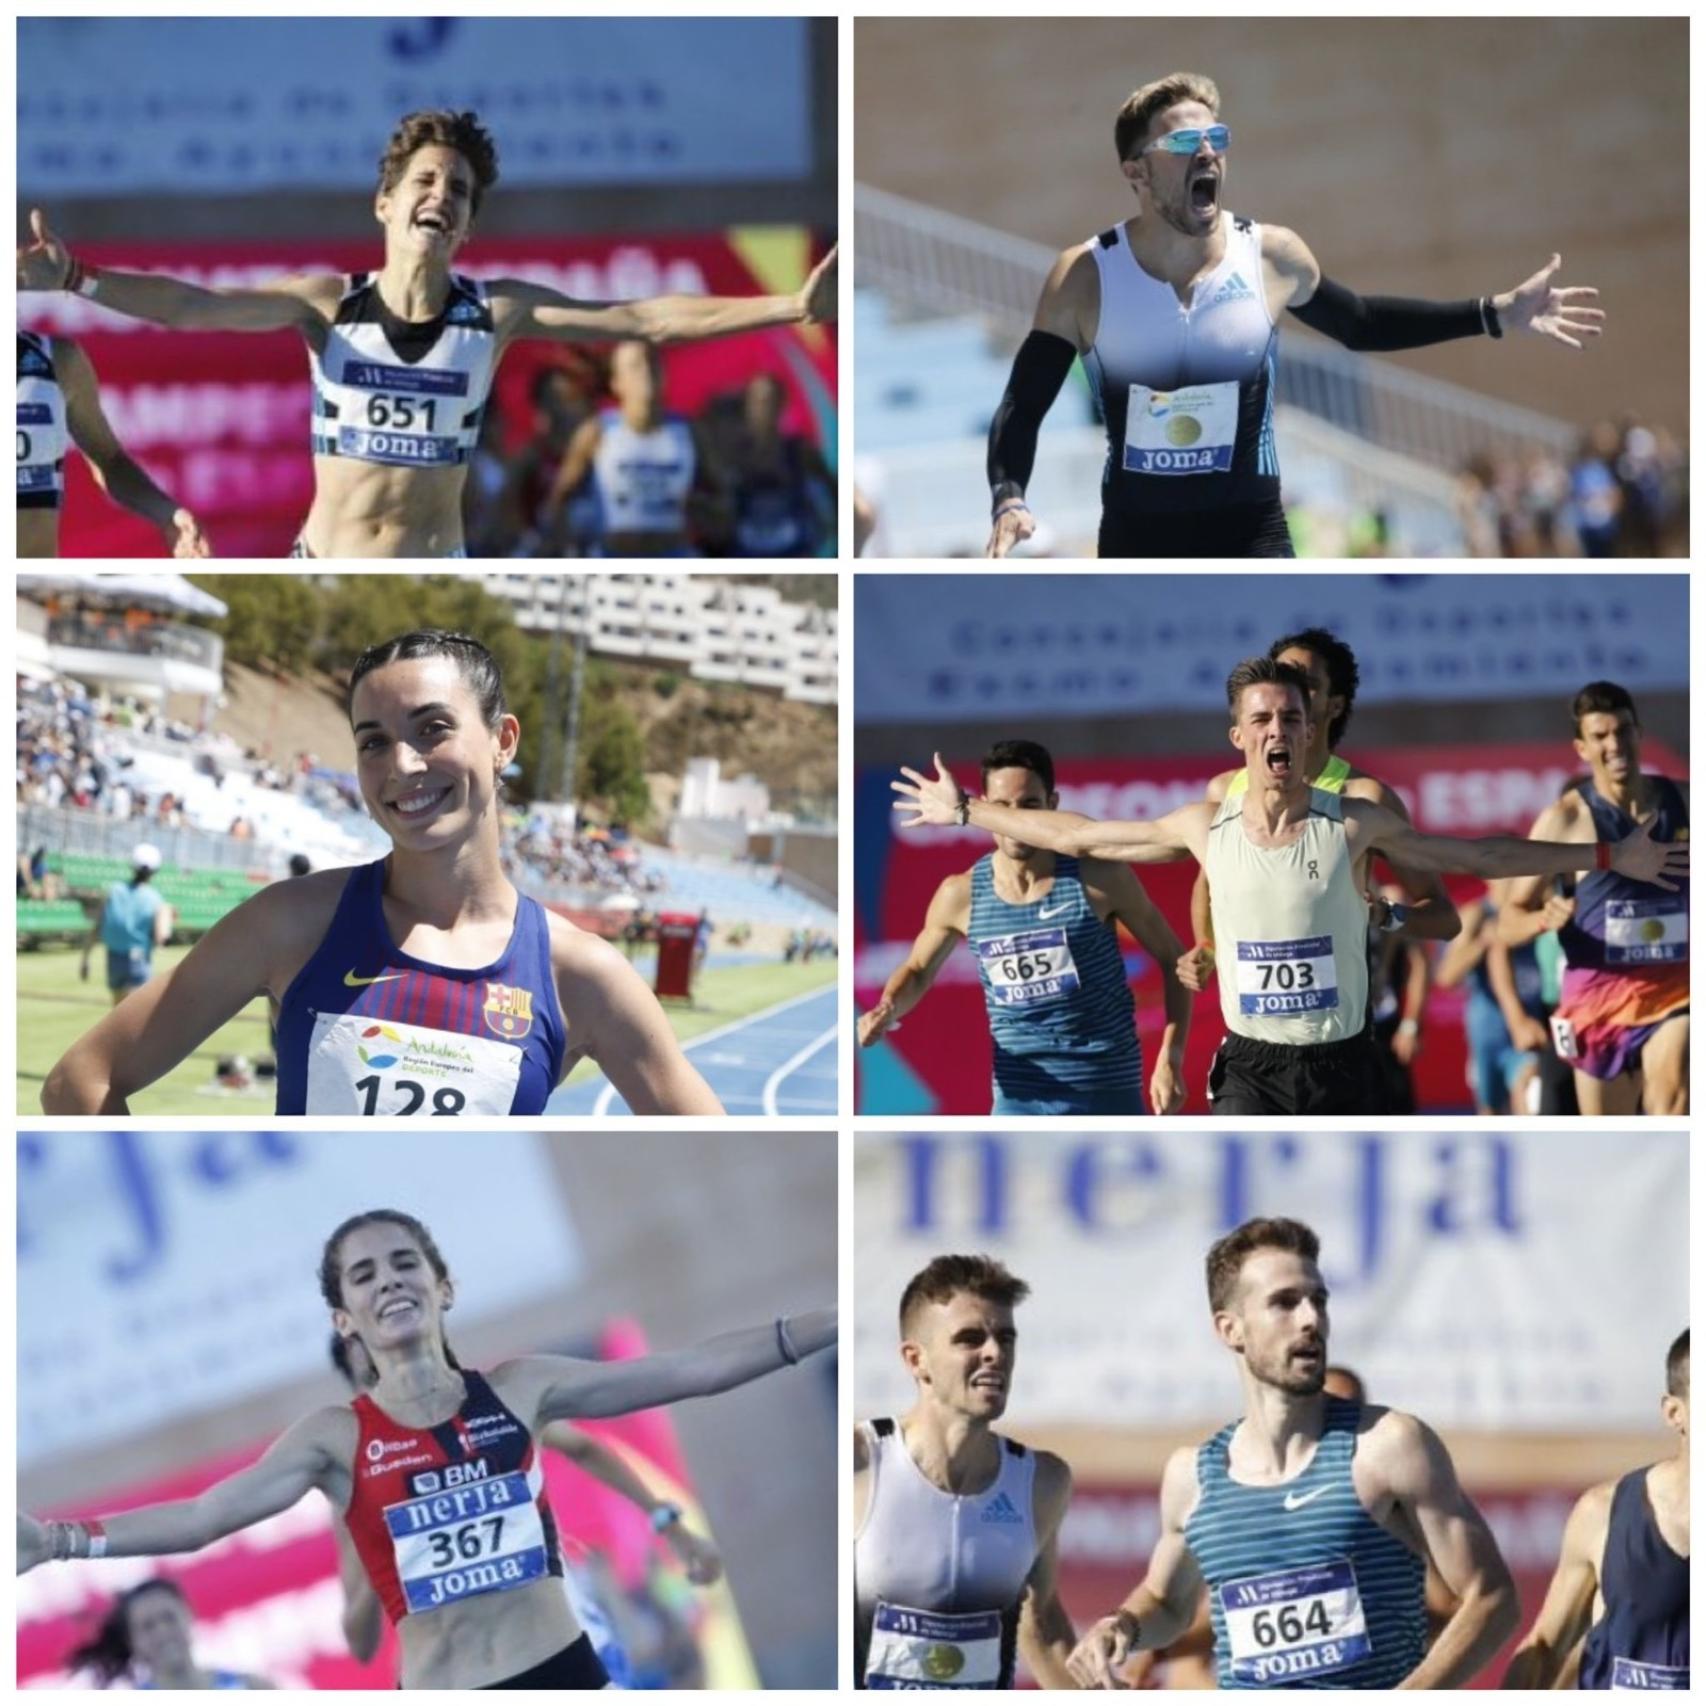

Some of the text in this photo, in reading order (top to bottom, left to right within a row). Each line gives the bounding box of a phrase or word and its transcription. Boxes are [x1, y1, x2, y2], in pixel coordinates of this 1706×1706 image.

[367, 394, 437, 432] 651
[357, 432, 438, 458] Joma
[1142, 449, 1214, 469] Joma
[1002, 953, 1052, 980] 665
[1256, 963, 1314, 990] 703
[1005, 980, 1061, 1002] Joma
[1256, 992, 1319, 1013] Joma
[356, 1075, 466, 1116] 128
[444, 1460, 487, 1486] BM
[406, 1480, 511, 1529] nerja
[428, 1516, 505, 1569] 367
[430, 1557, 524, 1604] Joma
[1253, 1600, 1333, 1648] 664
[1255, 1643, 1343, 1681] Joma
